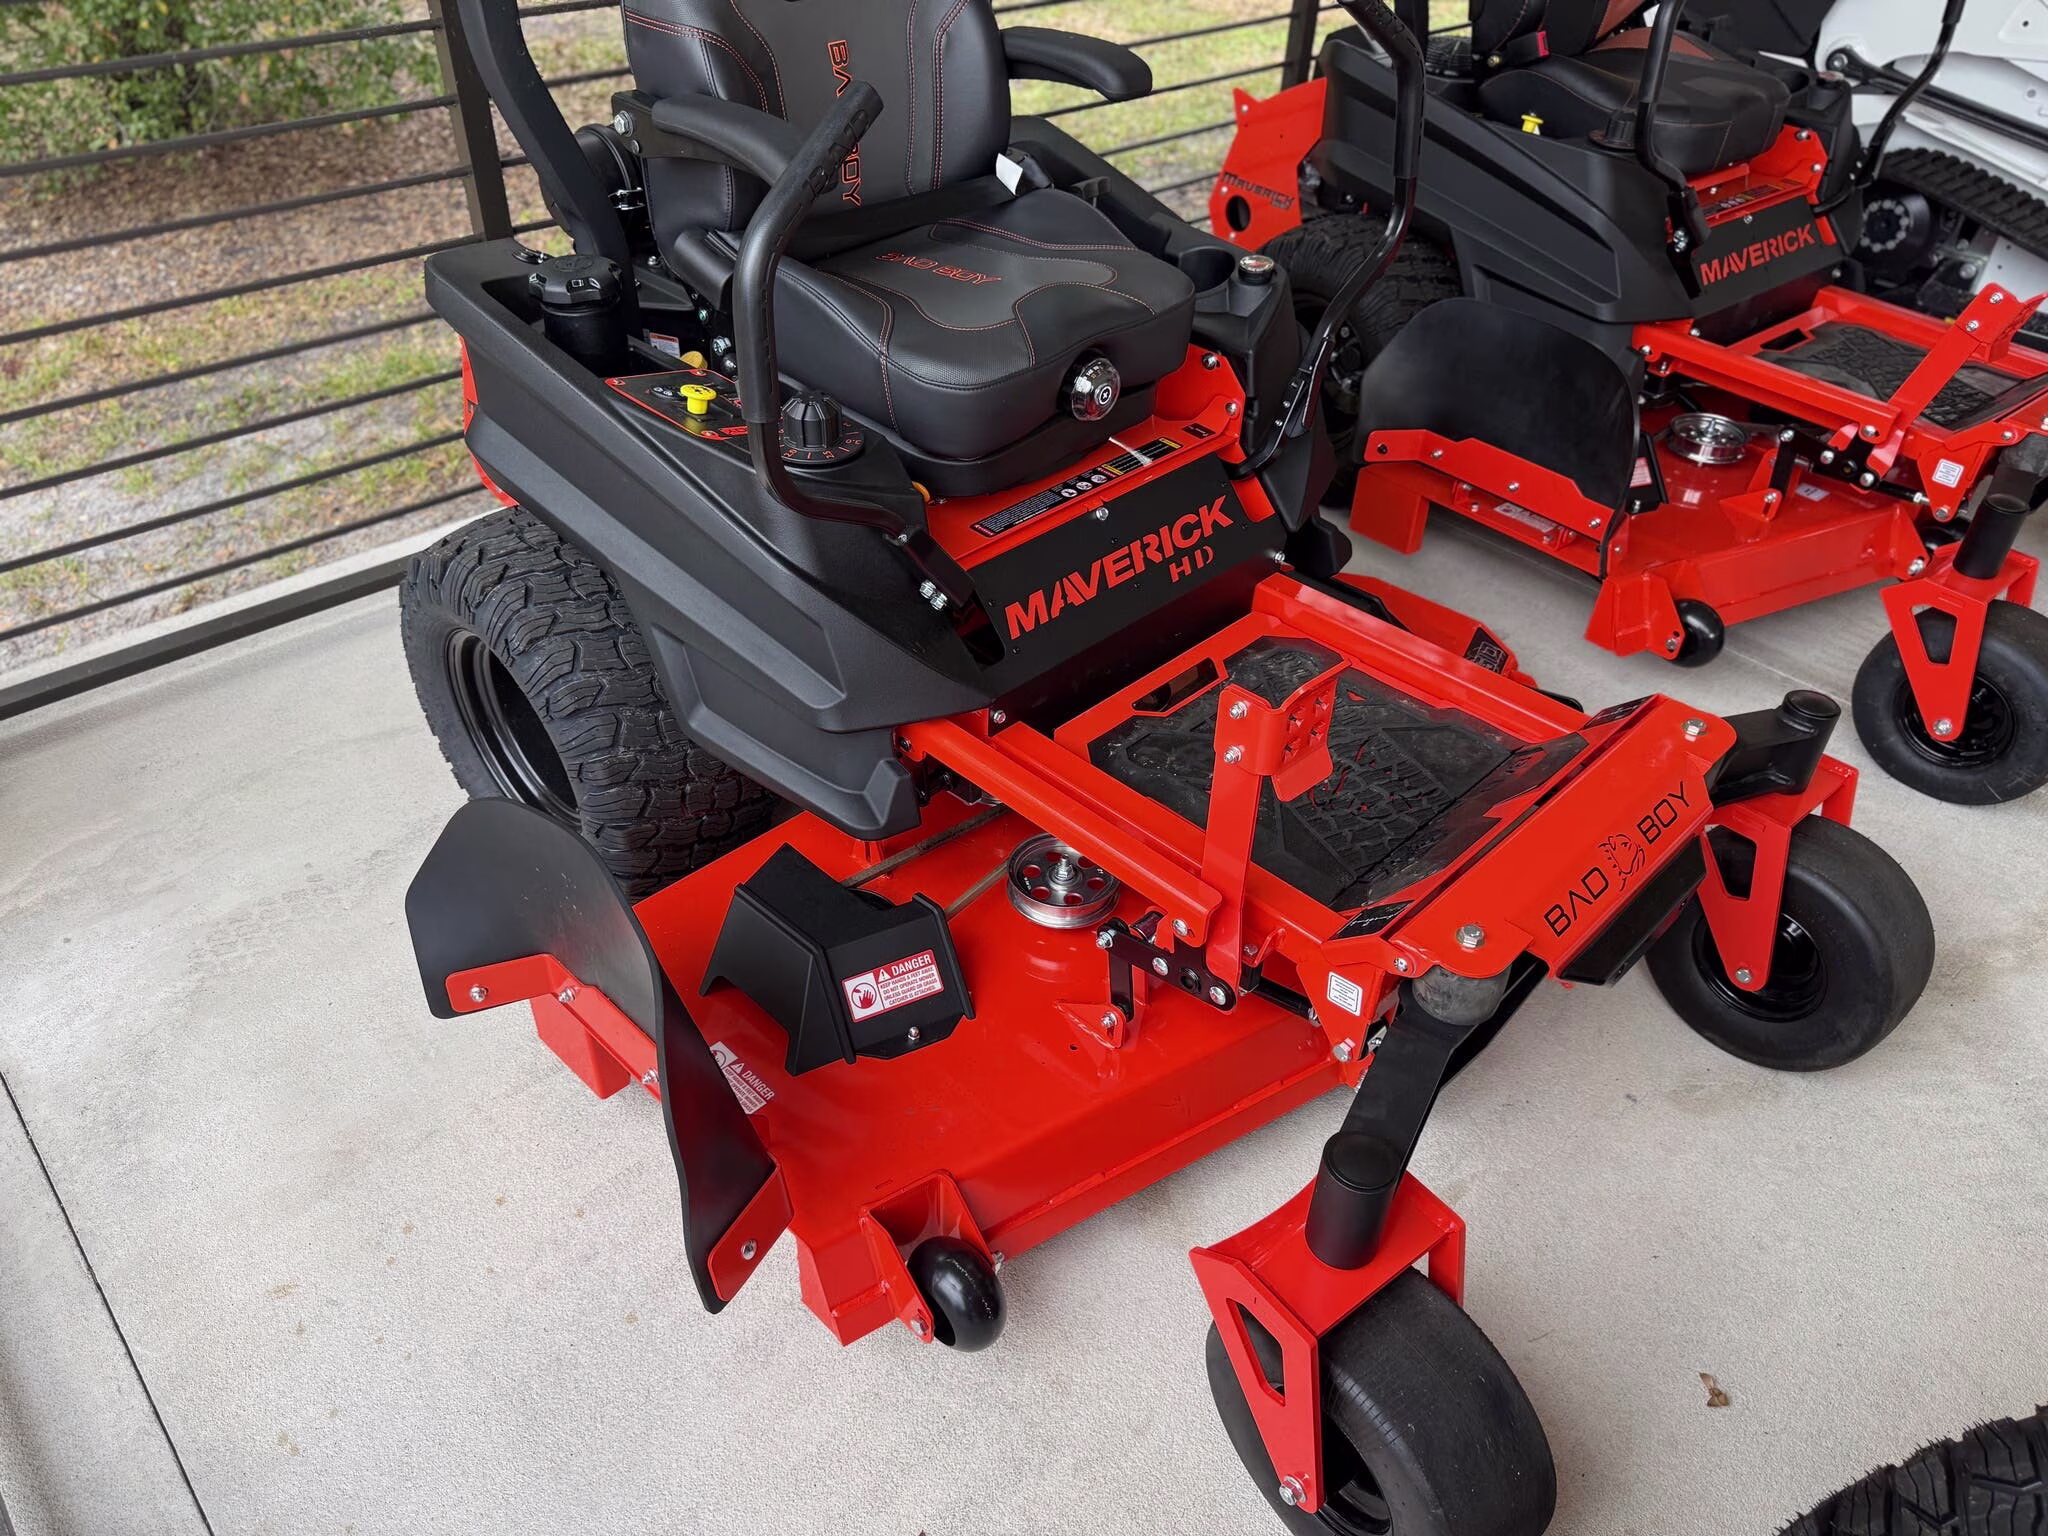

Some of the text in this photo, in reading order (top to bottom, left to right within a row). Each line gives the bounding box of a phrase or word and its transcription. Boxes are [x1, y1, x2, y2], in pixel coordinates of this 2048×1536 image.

[827, 40, 862, 207] BA OY
[932, 265, 1002, 285] BOY
[1699, 223, 1816, 287] MAVERICK
[1004, 494, 1234, 640] MAVERICK
[1168, 545, 1214, 583] HD
[1543, 780, 1690, 938] BAD BOY
[891, 954, 932, 976] DANGER
[742, 1070, 775, 1101] DANGER
